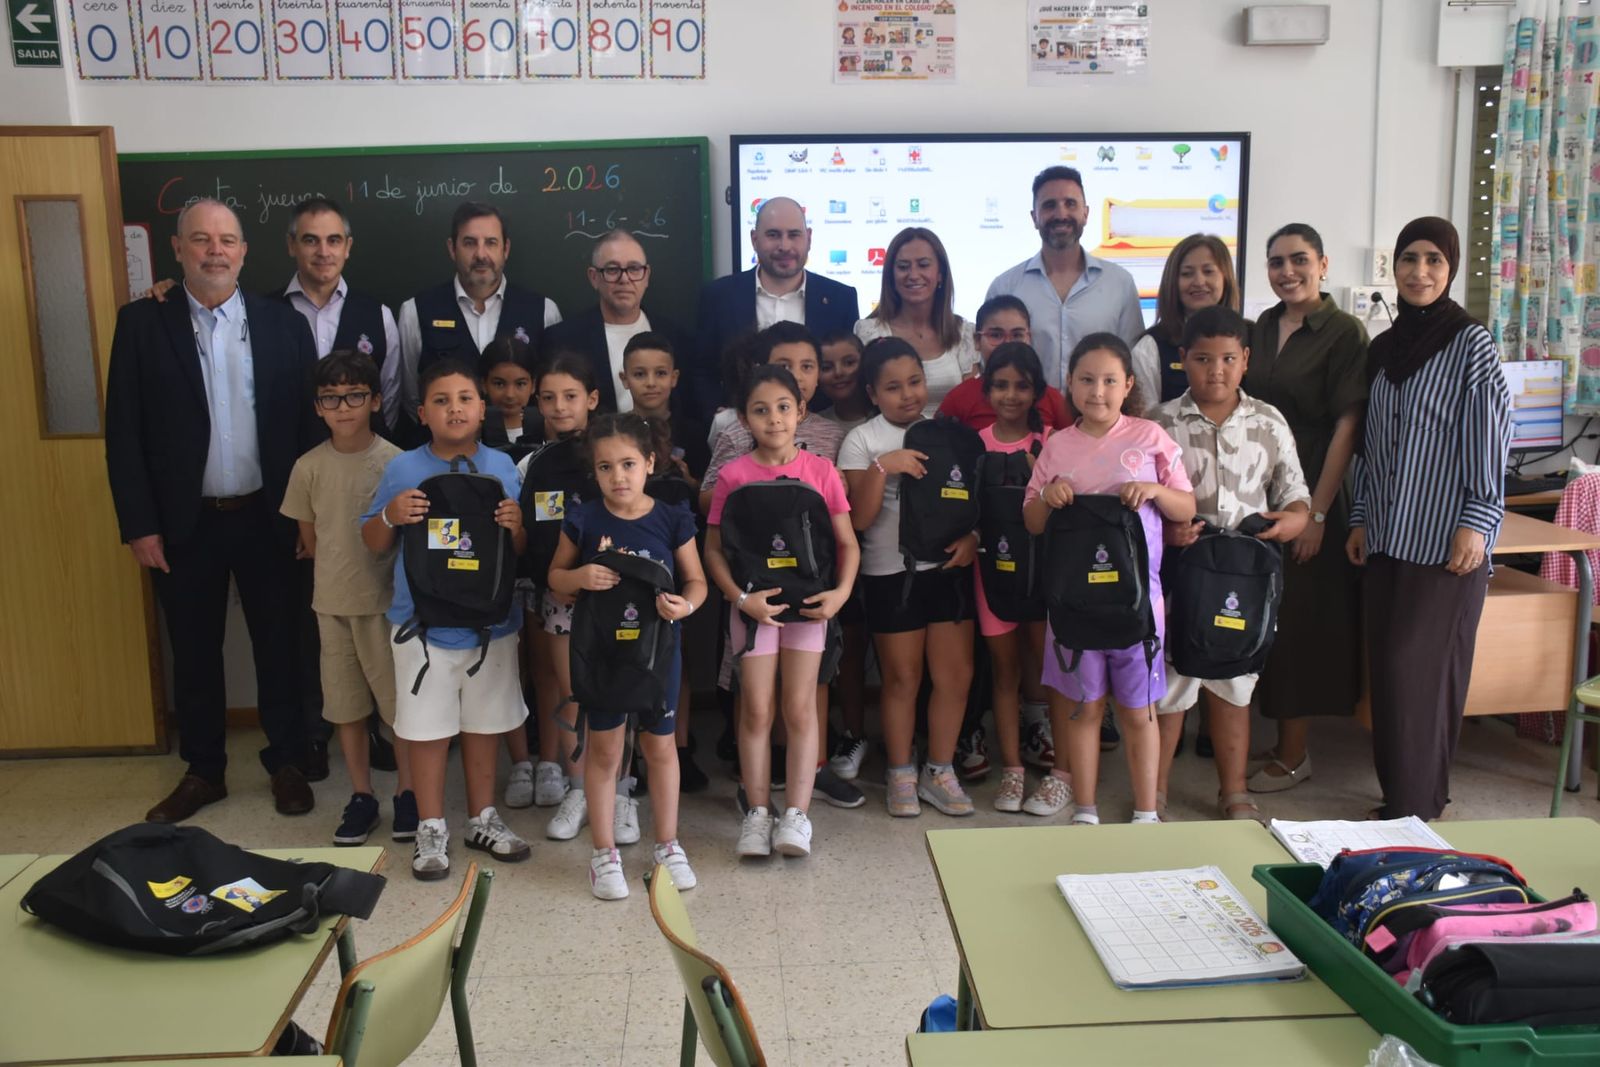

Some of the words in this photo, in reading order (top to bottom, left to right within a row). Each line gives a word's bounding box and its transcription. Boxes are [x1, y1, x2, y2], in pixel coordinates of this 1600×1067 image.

[83, 2, 118, 11] cero
[151, 0, 186, 13] diez
[213, 0, 254, 9] veinte
[278, 0, 322, 9] treinta
[593, 0, 637, 8] ochenta
[653, 0, 701, 8] noventa
[88, 24, 117, 62] 0
[146, 25, 191, 60] 10
[210, 19, 261, 54] 20
[277, 19, 327, 54] 30
[340, 18, 389, 52] 40
[403, 16, 451, 50] 50
[463, 18, 514, 52] 60
[527, 18, 576, 51] 70
[588, 19, 639, 52] 80
[651, 19, 701, 52] 90
[17, 48, 57, 60] SALIDA
[376, 174, 406, 199] de
[416, 178, 477, 215] junio
[489, 165, 518, 194] de
[541, 164, 621, 193] 2.026
